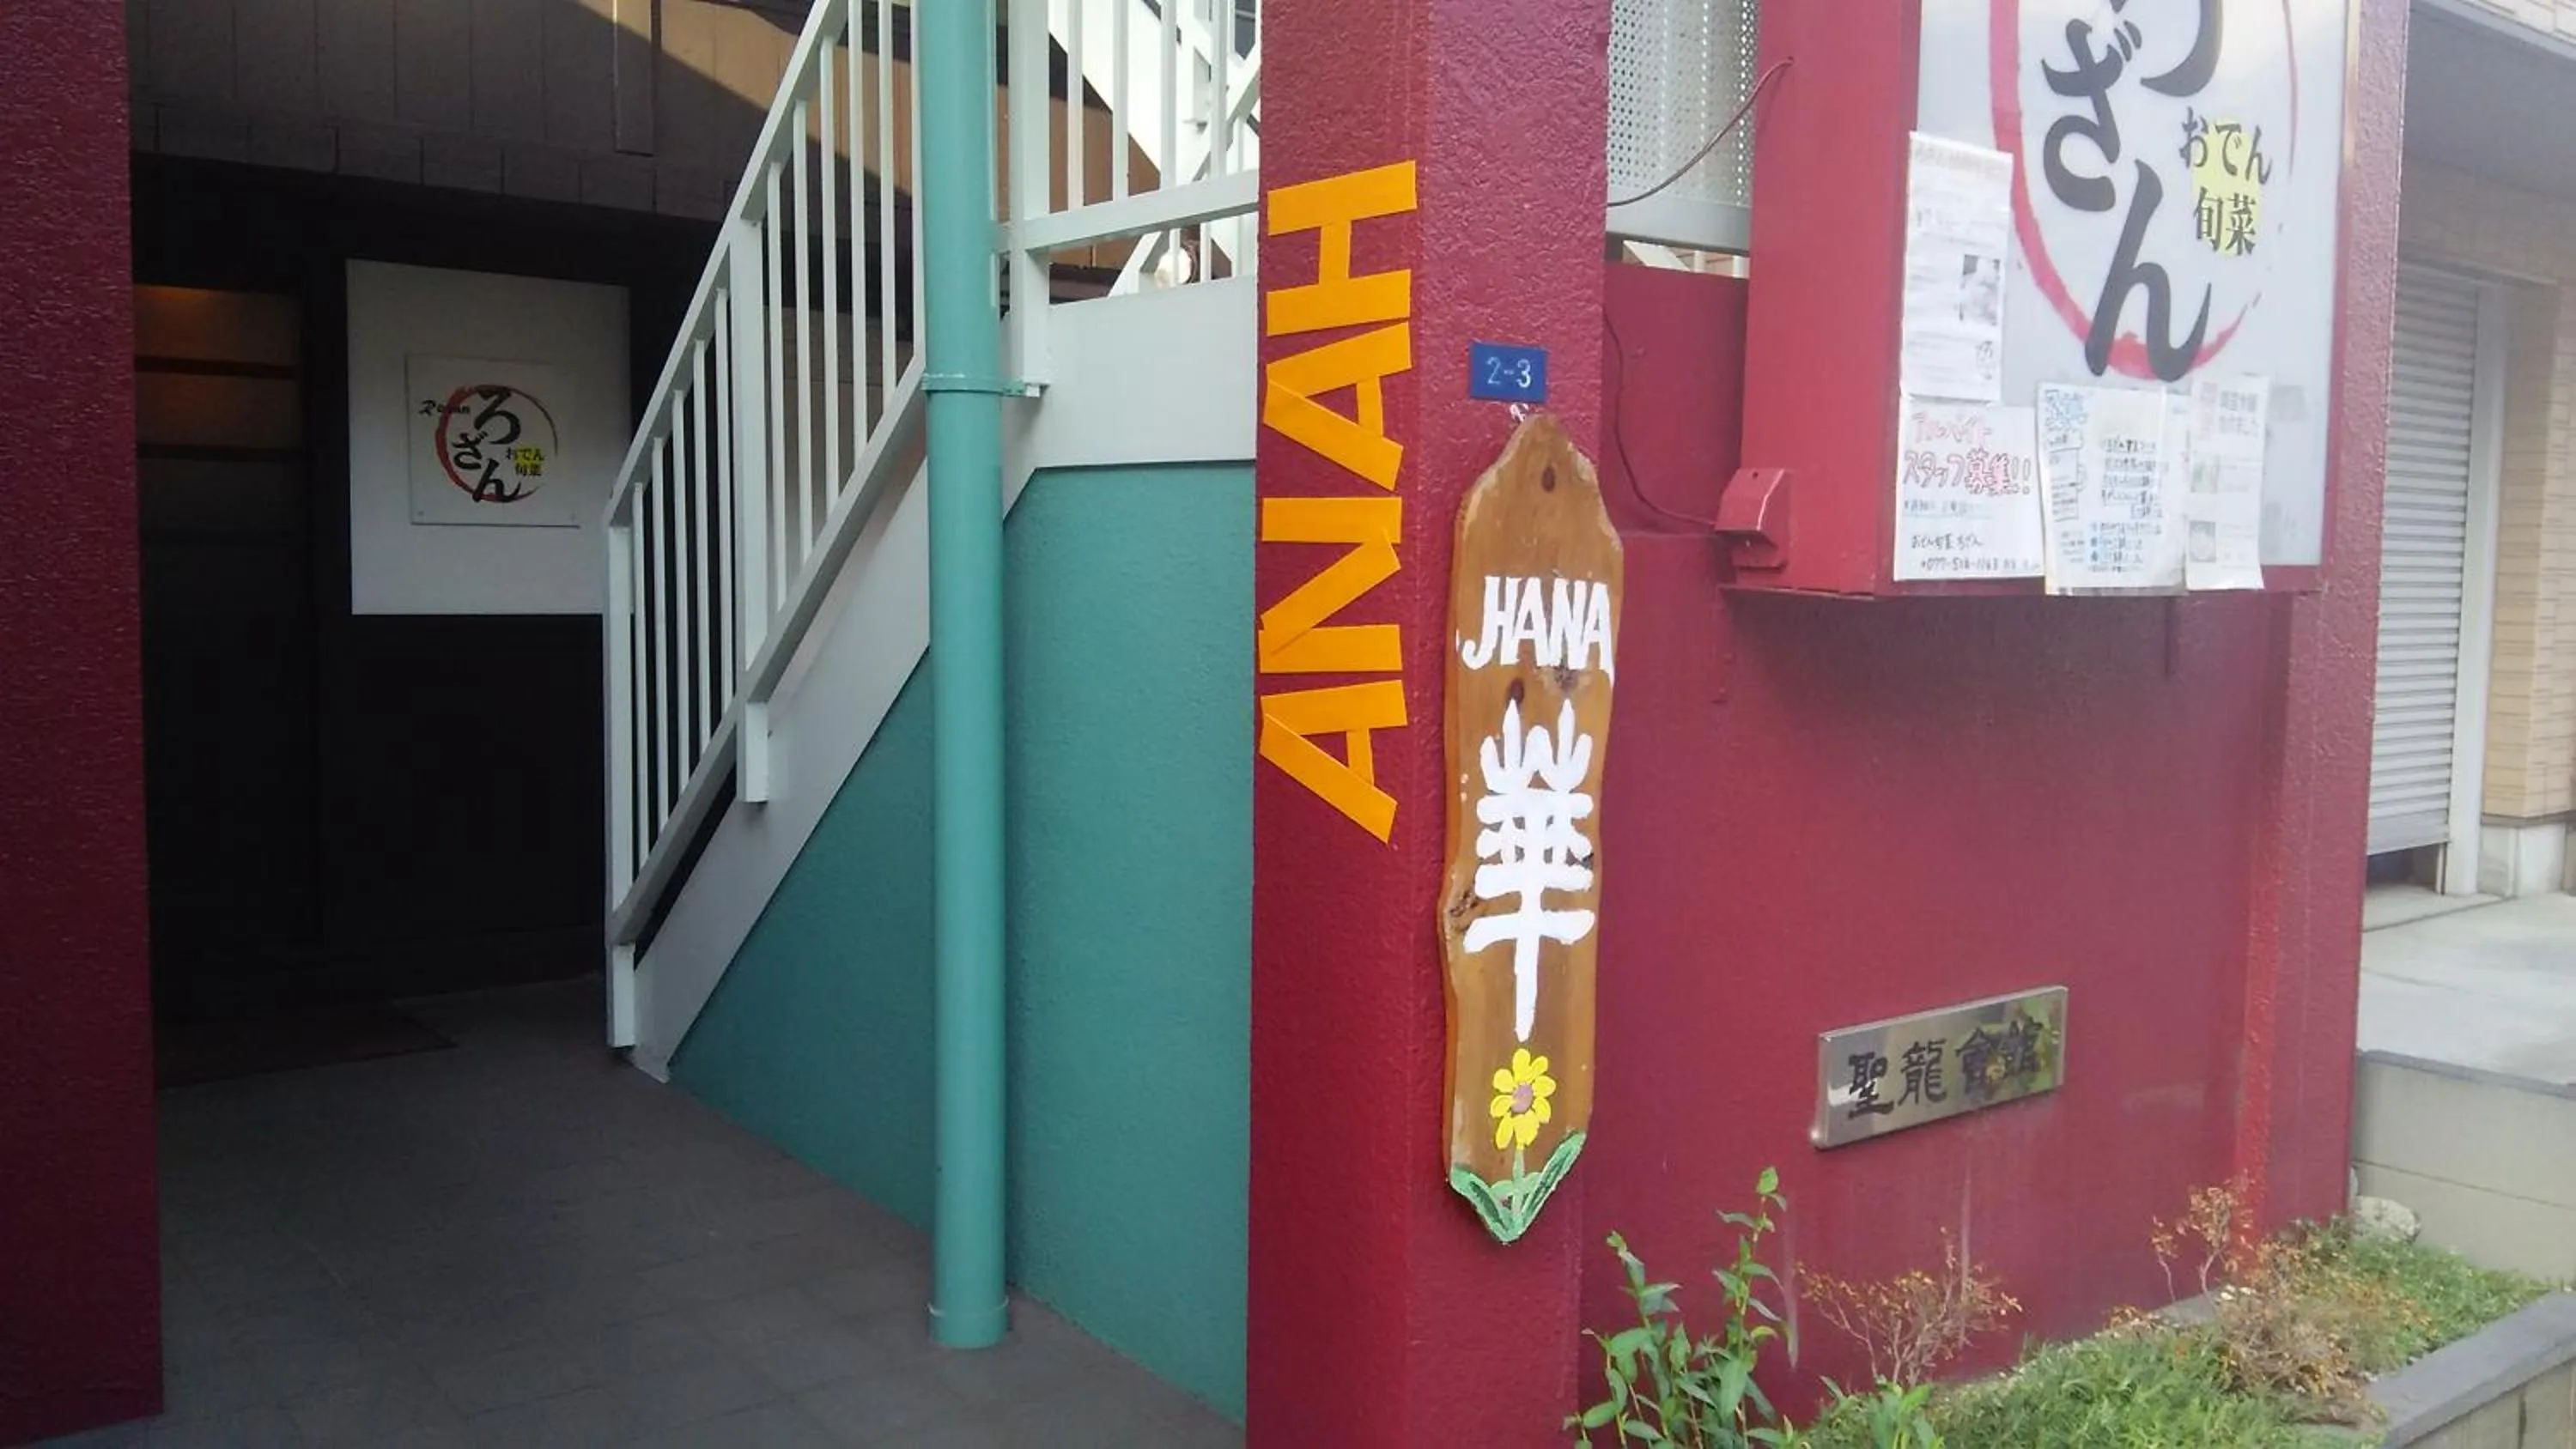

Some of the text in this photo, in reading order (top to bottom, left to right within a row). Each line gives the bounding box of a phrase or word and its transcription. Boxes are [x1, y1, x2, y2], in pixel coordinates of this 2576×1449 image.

[2178, 106, 2273, 185] おでん
[2194, 186, 2257, 257] 旬菜
[1486, 356, 1531, 388] 2-3
[452, 385, 520, 502] ろざん
[506, 447, 544, 461] おでん
[1259, 160, 1417, 844] HANA
[1461, 575, 1615, 687] HANA
[1462, 698, 1595, 1044] 華
